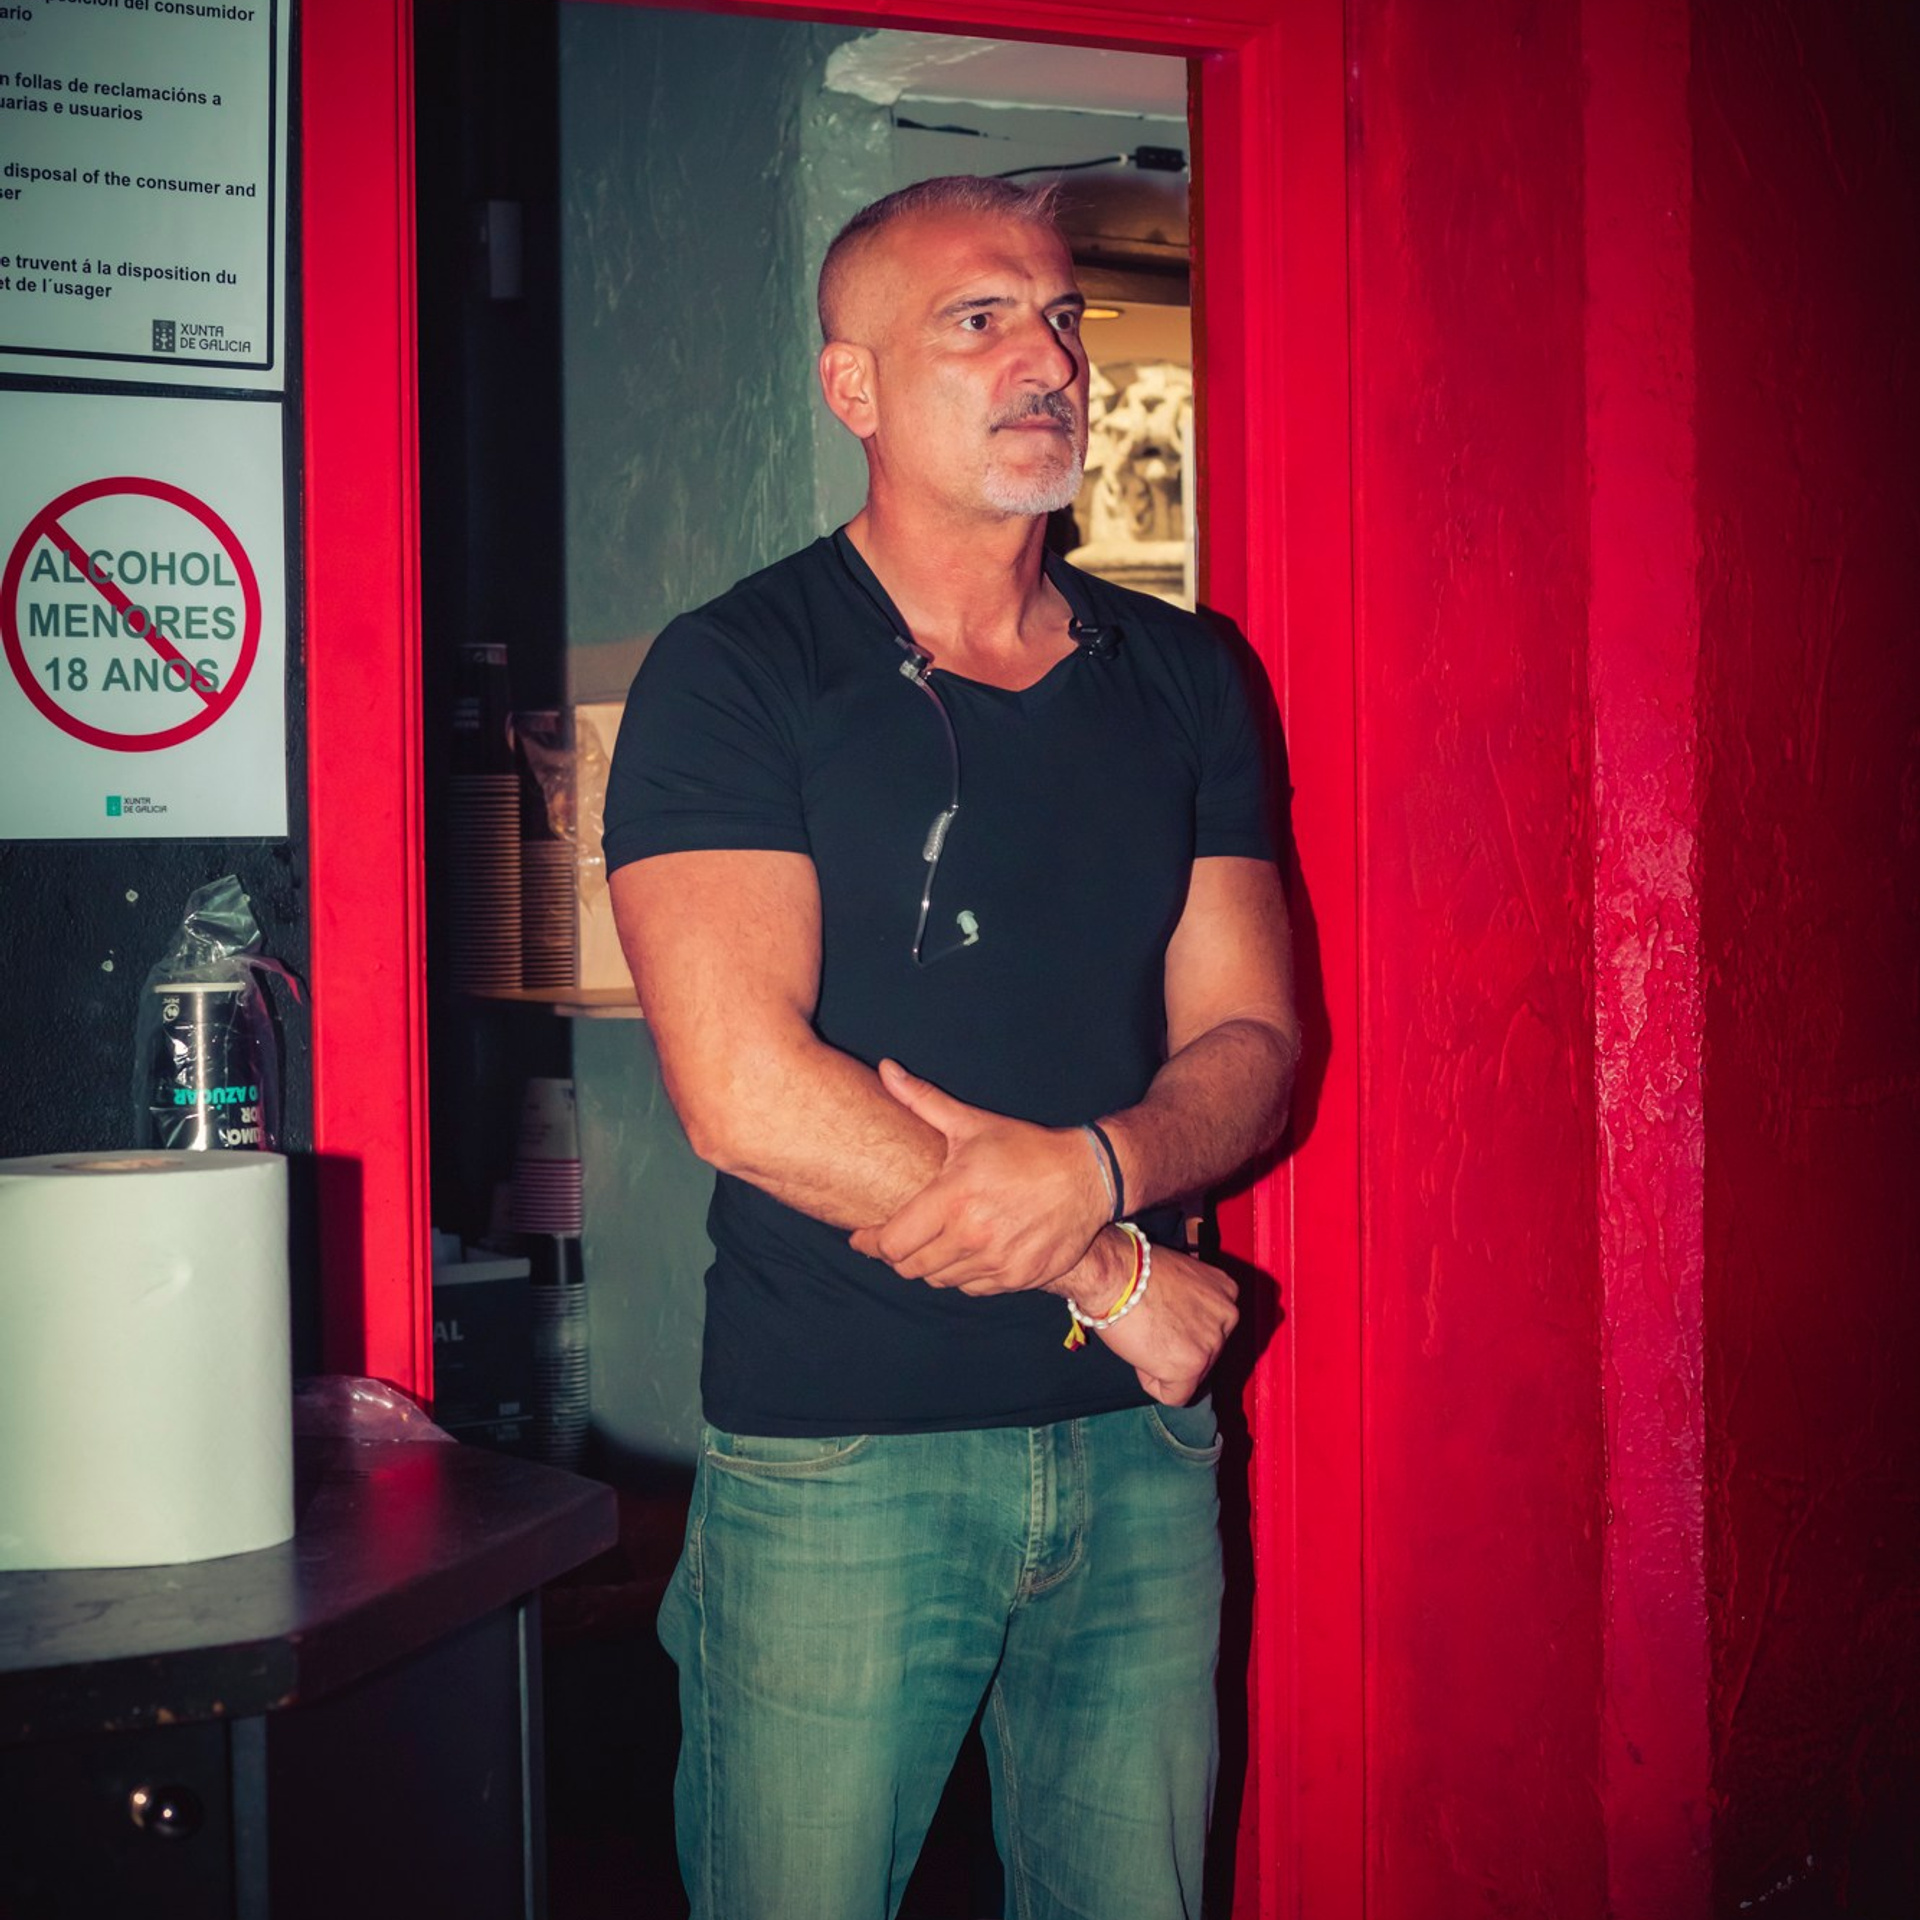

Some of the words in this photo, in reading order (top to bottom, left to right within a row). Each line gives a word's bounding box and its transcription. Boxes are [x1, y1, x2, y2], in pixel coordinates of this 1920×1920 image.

[154, 1, 255, 21] consumidor
[15, 72, 62, 91] follas
[68, 78, 89, 93] de
[94, 82, 207, 104] reclamacións
[212, 94, 221, 106] a
[53, 101, 64, 114] e
[69, 103, 142, 120] usuarios
[4, 162, 77, 182] disposal
[82, 169, 100, 184] of
[104, 171, 131, 187] the
[136, 176, 221, 194] consumer
[225, 183, 256, 197] and
[16, 254, 77, 273] truvent
[98, 260, 111, 275] la
[117, 262, 210, 282] disposition
[216, 270, 237, 284] du
[16, 277, 37, 292] de
[181, 323, 224, 337] XUNTA
[180, 337, 196, 349] DE
[199, 338, 251, 352] GALICIA
[30, 549, 236, 586] ALCOHOL
[29, 603, 236, 640] MENORES
[44, 657, 88, 691] 18
[102, 657, 220, 693] ANOS
[124, 797, 151, 805] XUNTA
[124, 805, 133, 814] DE
[135, 805, 167, 814] GALICIA
